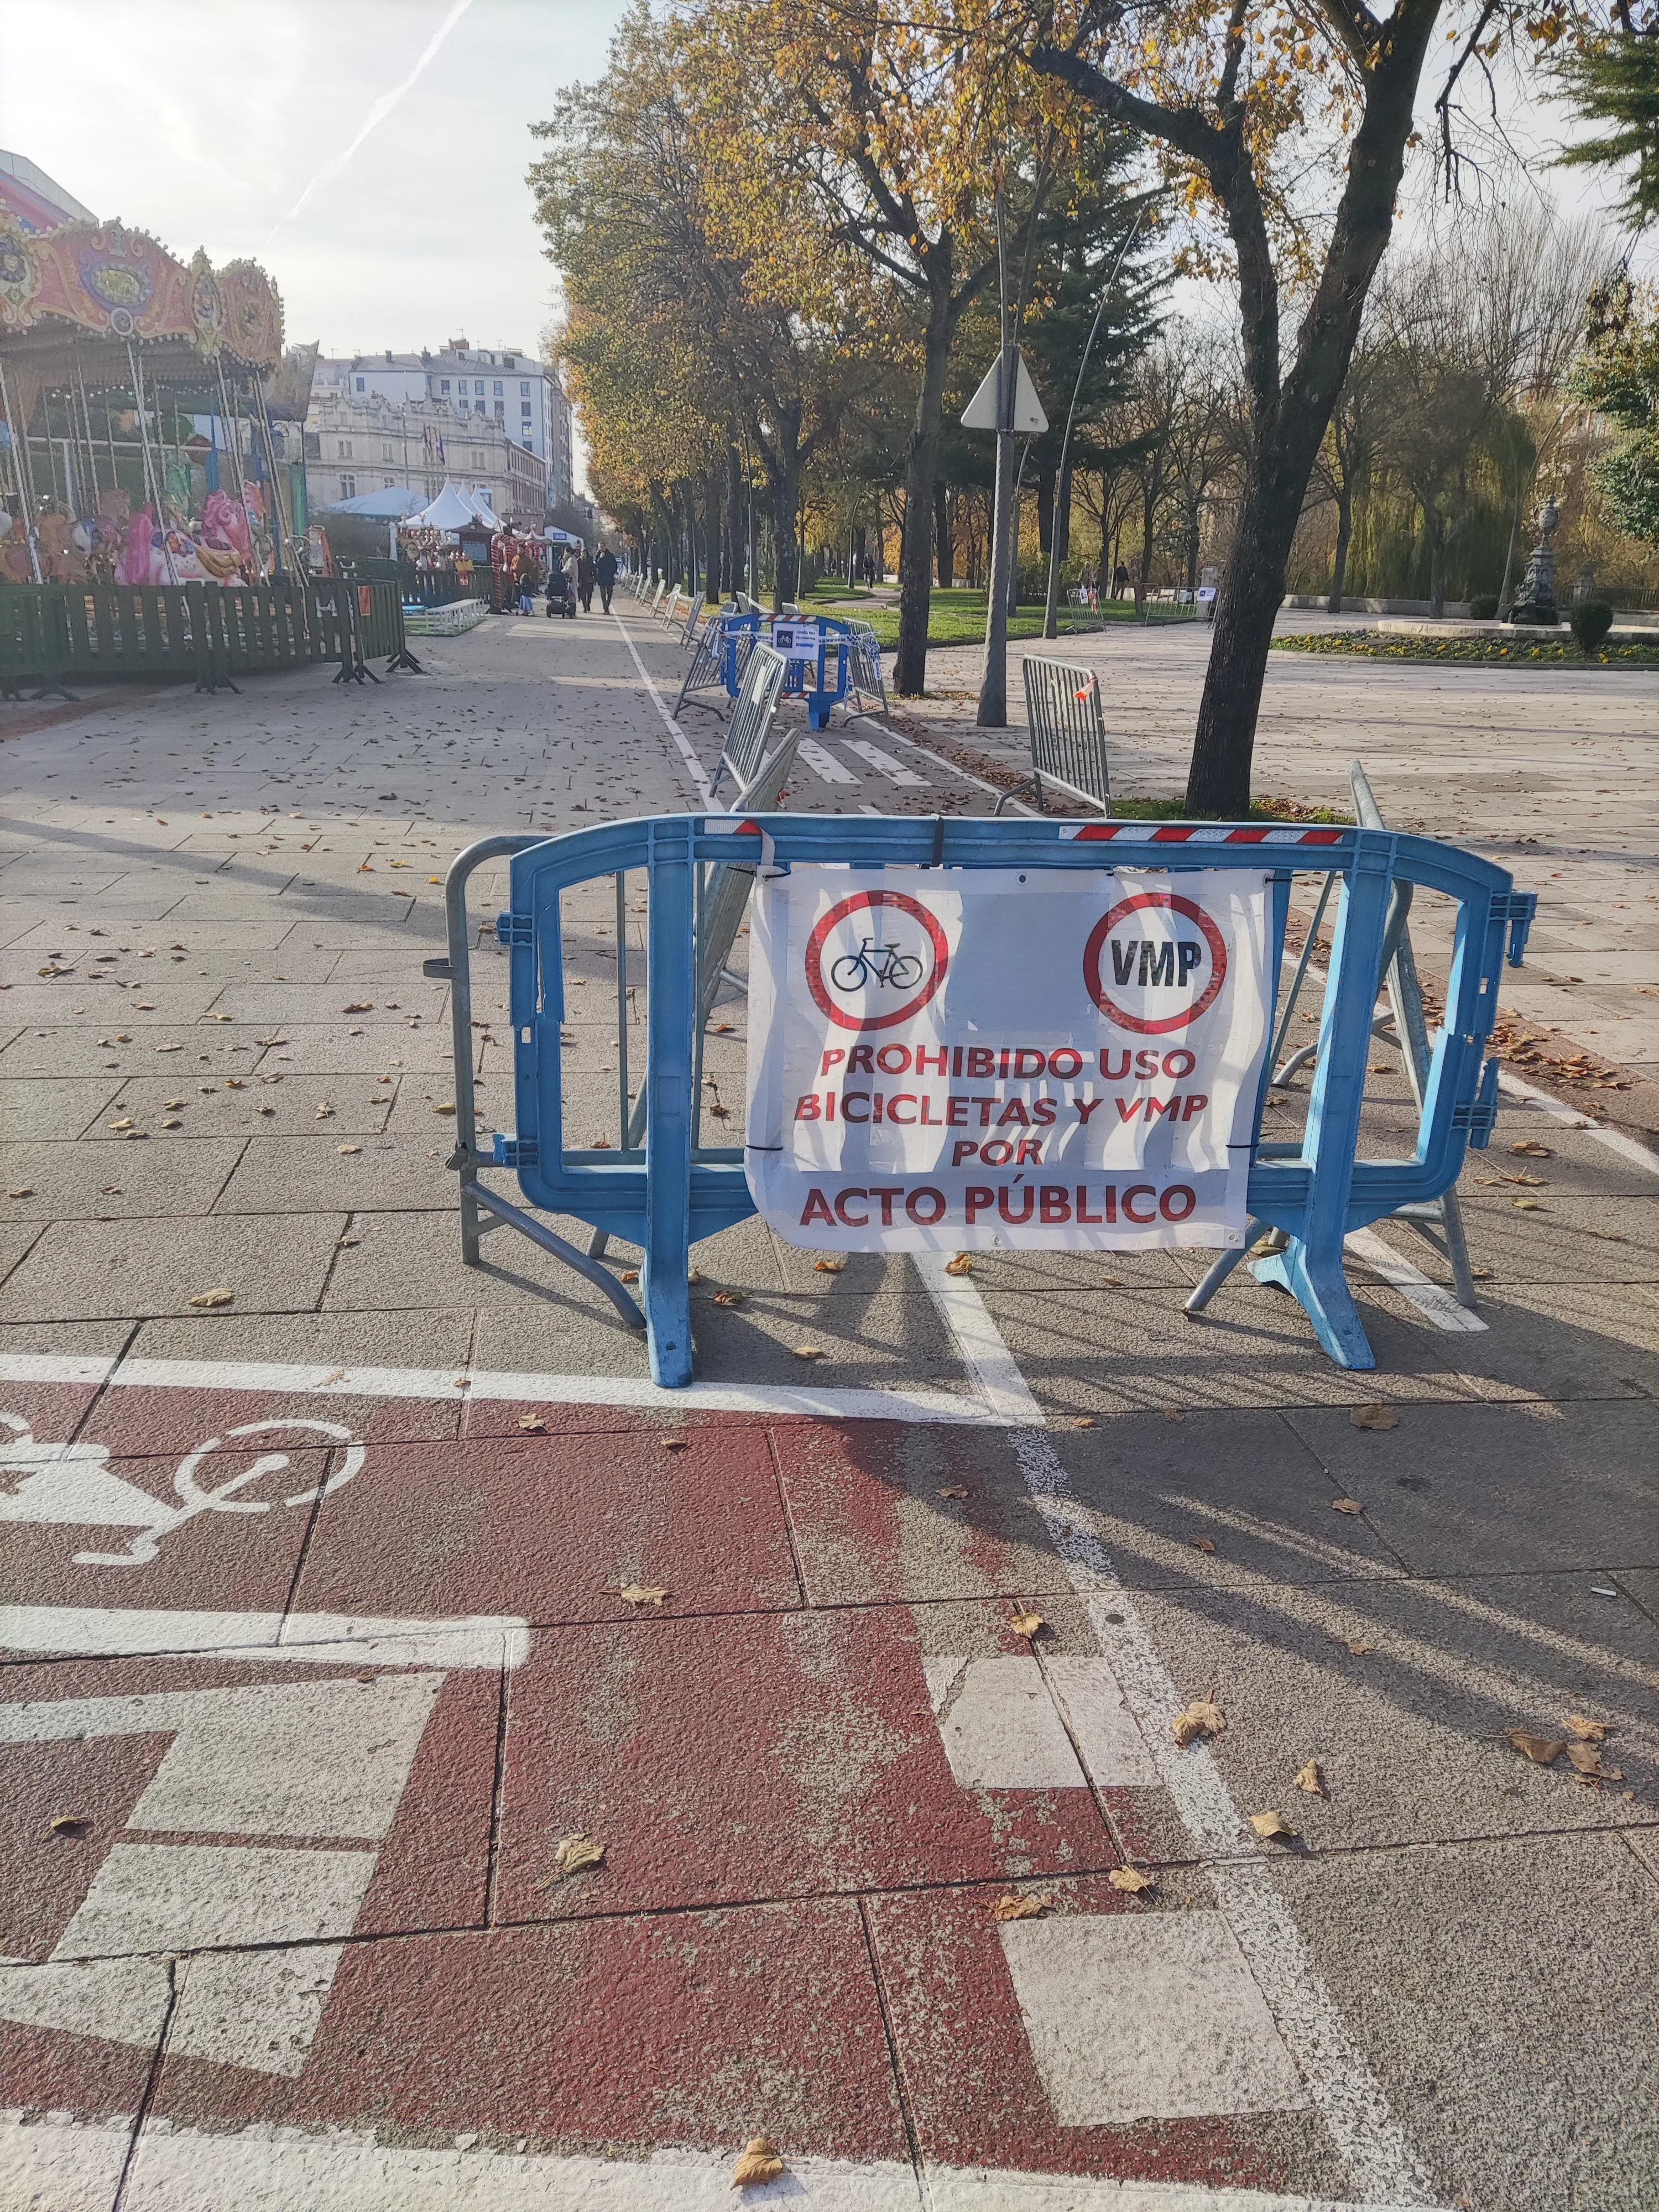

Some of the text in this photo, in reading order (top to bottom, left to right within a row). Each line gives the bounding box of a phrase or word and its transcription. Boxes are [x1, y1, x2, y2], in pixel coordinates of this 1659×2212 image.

[1111, 940, 1202, 987] VMP
[821, 1045, 1196, 1080] PROHIBIDO USO
[794, 1092, 1209, 1126] BICICLETAS Y VMP
[951, 1140, 1042, 1167] POR
[799, 1174, 1196, 1227] ACTO PÚBLICO
